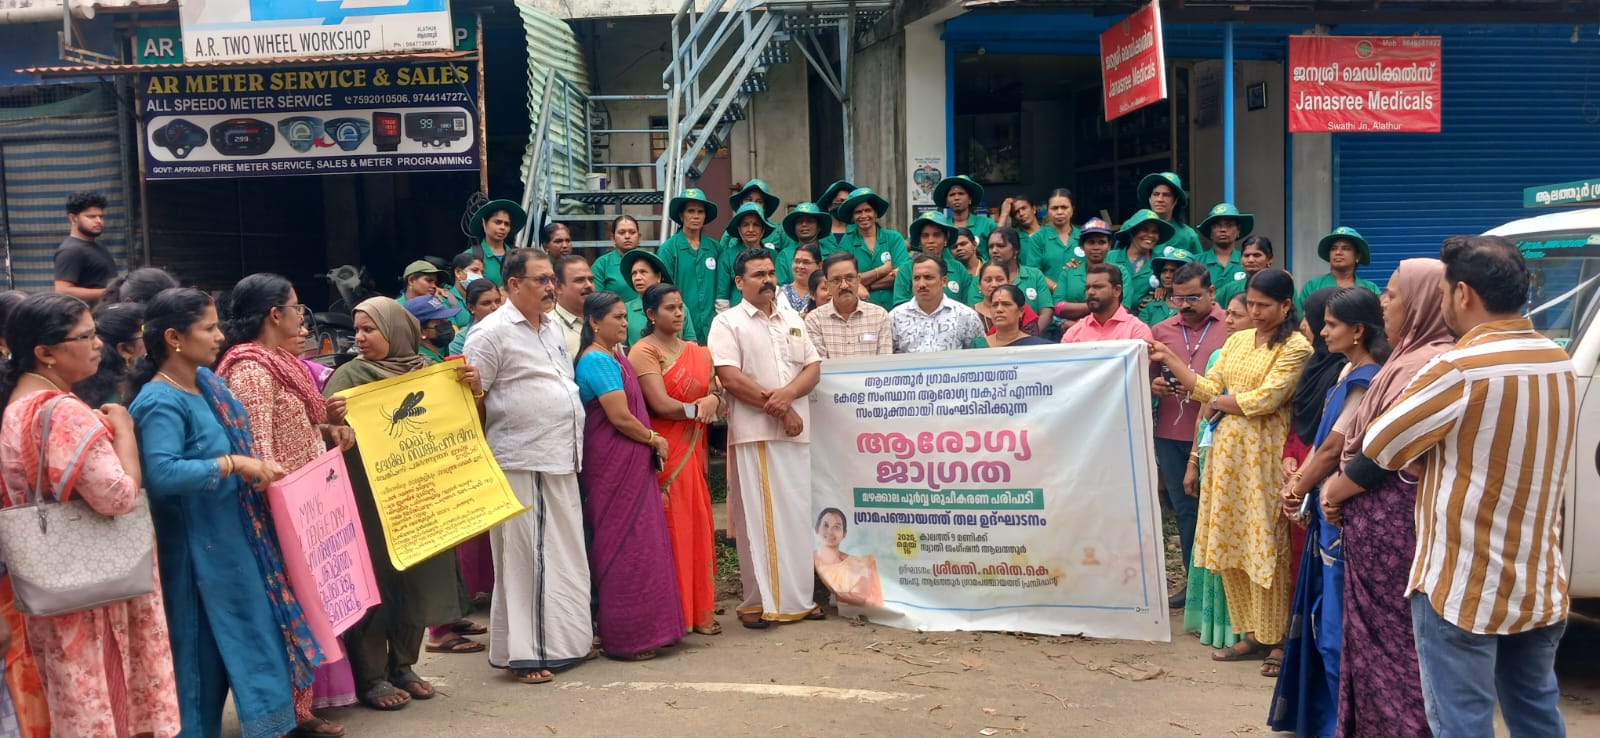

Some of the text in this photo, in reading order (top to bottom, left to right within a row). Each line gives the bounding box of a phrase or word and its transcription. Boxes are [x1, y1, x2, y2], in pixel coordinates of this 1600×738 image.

[143, 38, 175, 57] AR
[195, 29, 371, 57] A.R. TWO WHEEL WORKSHOP
[146, 65, 469, 94] AR METER SERVICE & SALES
[1131, 57, 1156, 87] Medicals
[1293, 62, 1436, 86] ജനശ്രീ മെഡിക്കൽസ്
[146, 93, 333, 112] ALL SPEEDO METER SERVICE
[1295, 90, 1433, 111] Janasree Medicals
[1328, 121, 1355, 131] Swathi
[1372, 121, 1402, 130] Alathur
[212, 164, 234, 172] FIRE
[236, 162, 269, 172] METER
[271, 161, 314, 171] SERVICE,
[316, 159, 348, 169] SALES
[350, 159, 357, 168] &
[360, 158, 393, 167] METER
[397, 156, 472, 166] PROGRAMMING
[1535, 182, 1590, 205] ആലത്തൂർ
[864, 367, 1019, 389] ആലത്തൂർ ഗ്രാമപഞ്ചായത്ത്
[833, 382, 1053, 405] കേരള സംസ്ഥാന ആരോഗ്യ വകുപ്പ് എന്നിവ
[855, 401, 1028, 420] സംയുക്തമായി സംഘടിപ്പിക്കുന്ന
[856, 429, 1032, 461] ആരോഗ്യ
[876, 459, 1011, 490] ജാഗ്രത
[861, 492, 900, 504] മഴക്കാല
[930, 491, 989, 506] ശുചീകരണ
[990, 490, 1034, 505] പരിപാടി
[854, 510, 1047, 528] ഗ്രാമപഞ്ചായത്ത് തല ഉദ്ഘാടനം
[919, 532, 950, 543] കാലത്ത്
[981, 545, 1027, 555] ആലത്തൂർ
